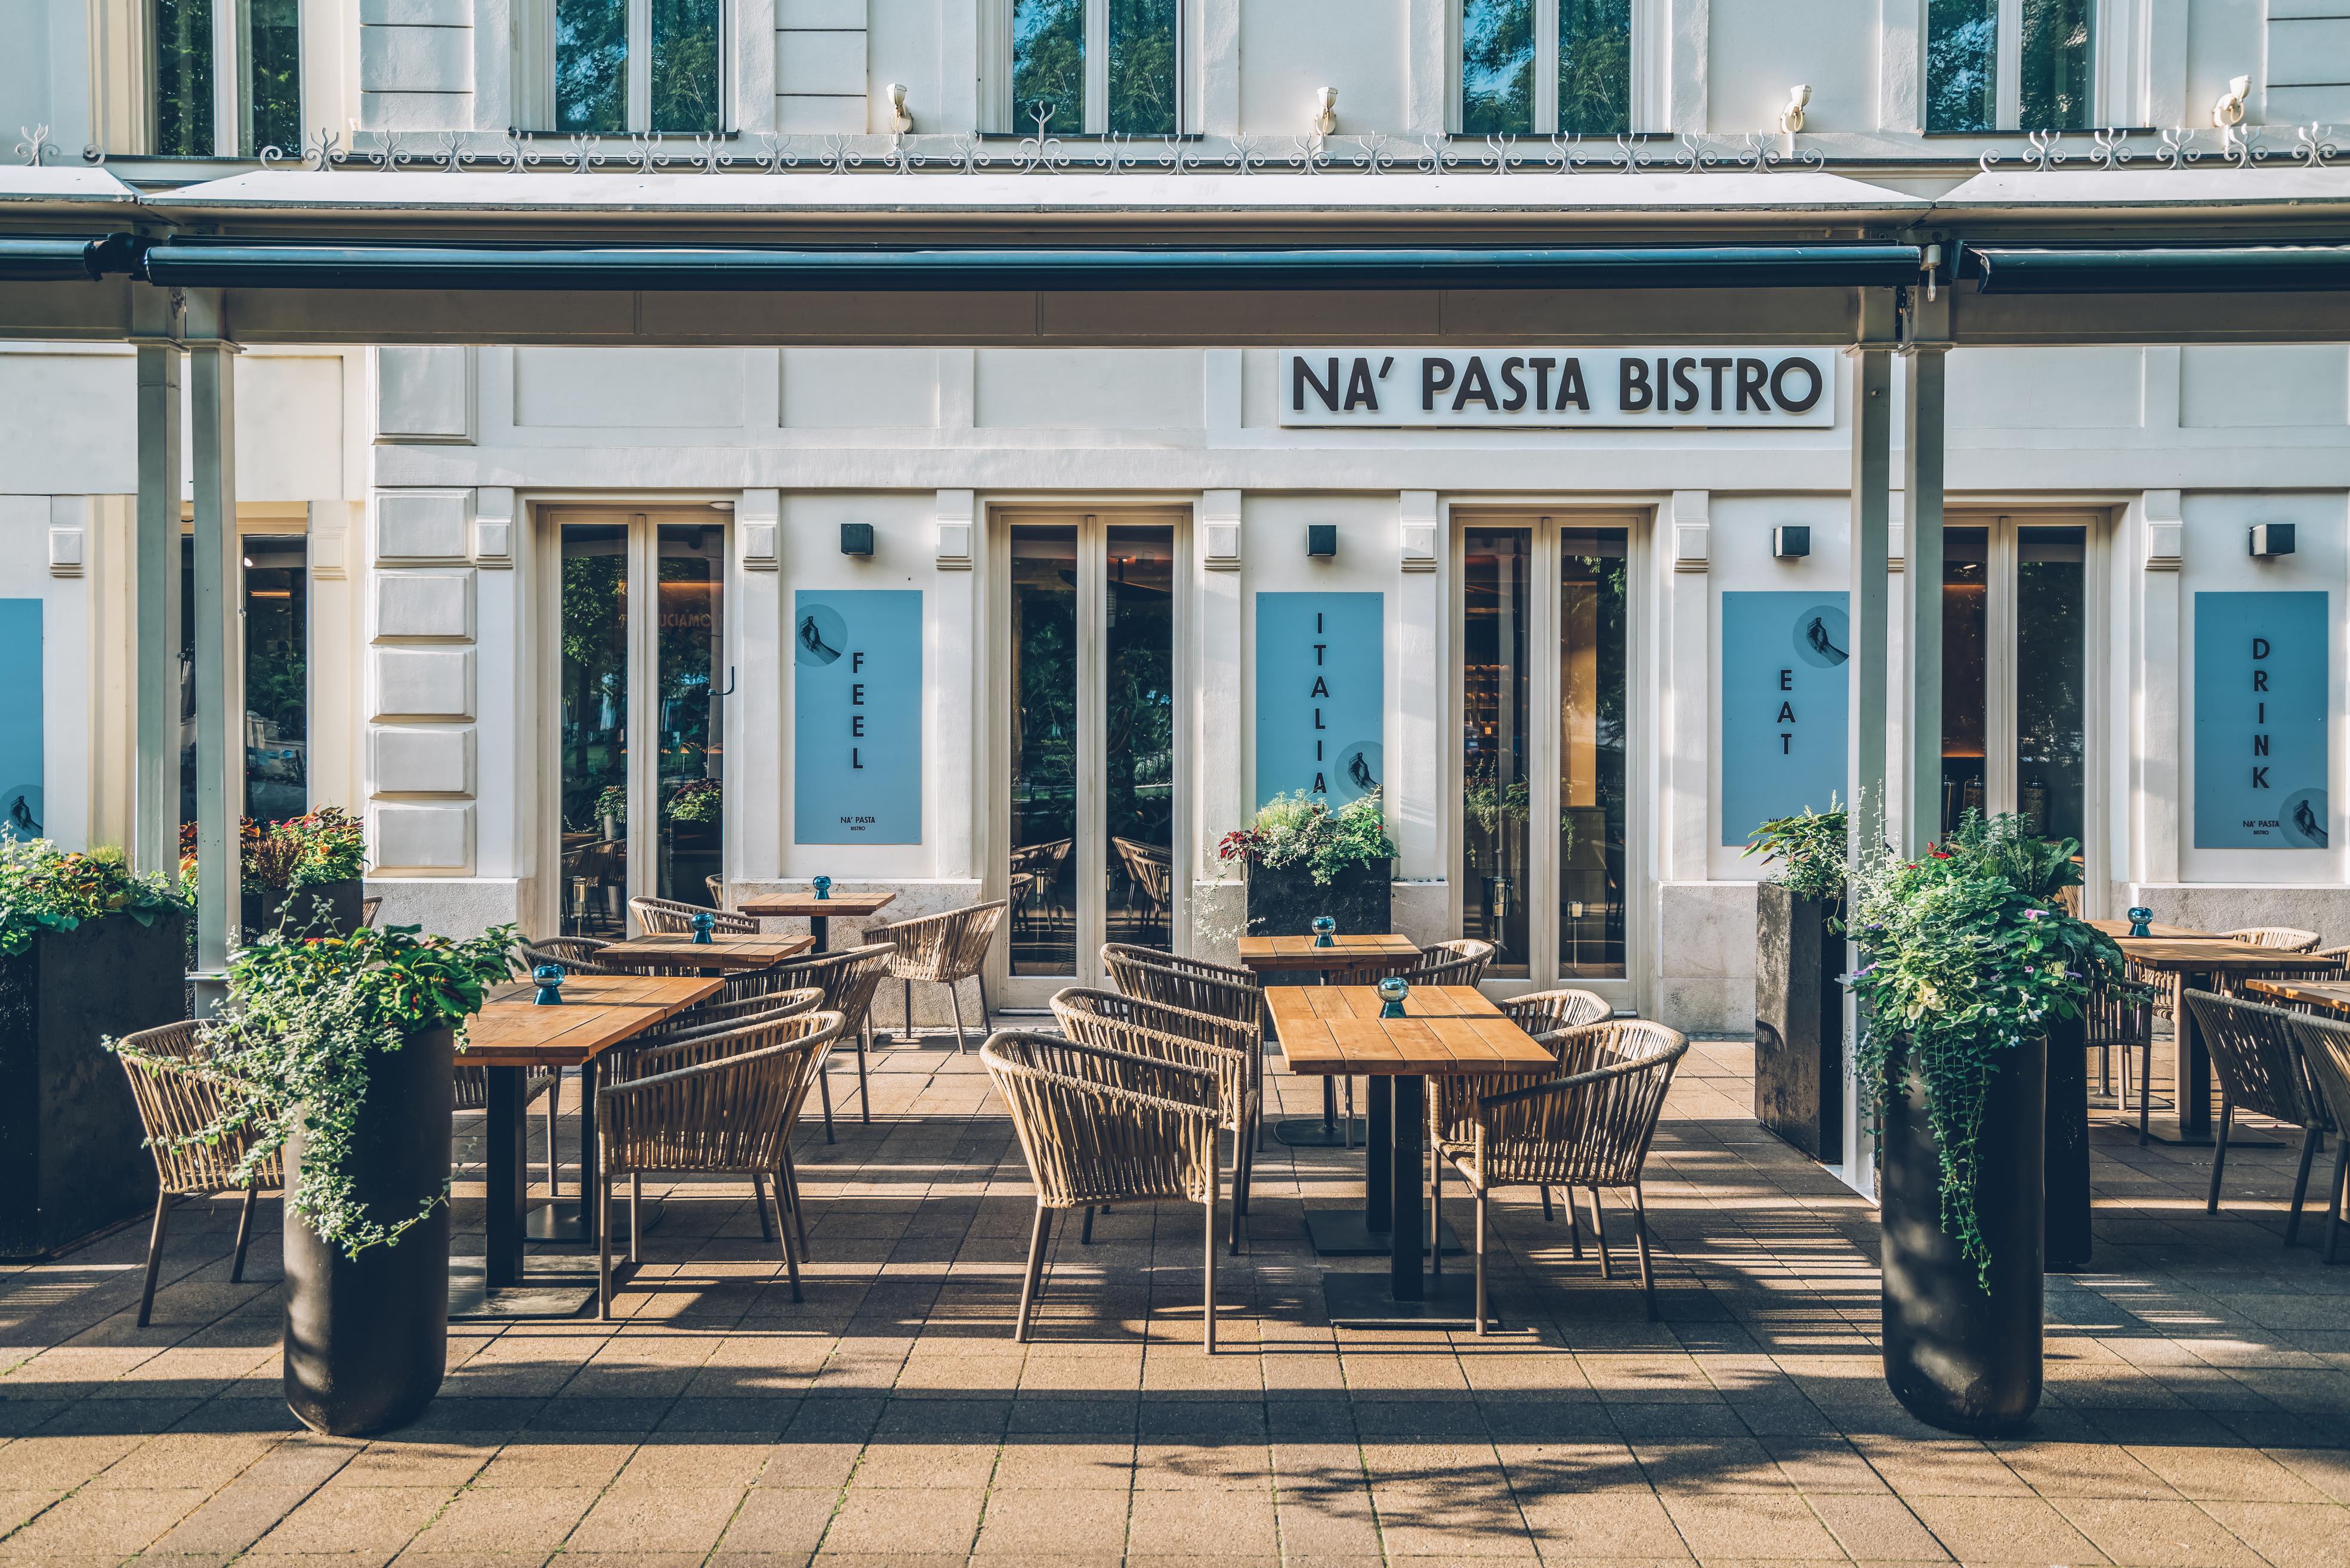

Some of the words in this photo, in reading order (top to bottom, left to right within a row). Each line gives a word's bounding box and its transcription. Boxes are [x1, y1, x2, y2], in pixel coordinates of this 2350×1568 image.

[1422, 356, 1591, 412] PASTA
[1619, 357, 1823, 413] BISTRO
[853, 652, 864, 769] FEEL
[1310, 612, 1330, 794] ITALIA
[1777, 669, 1796, 755] EAT
[2253, 638, 2271, 789] DRINK
